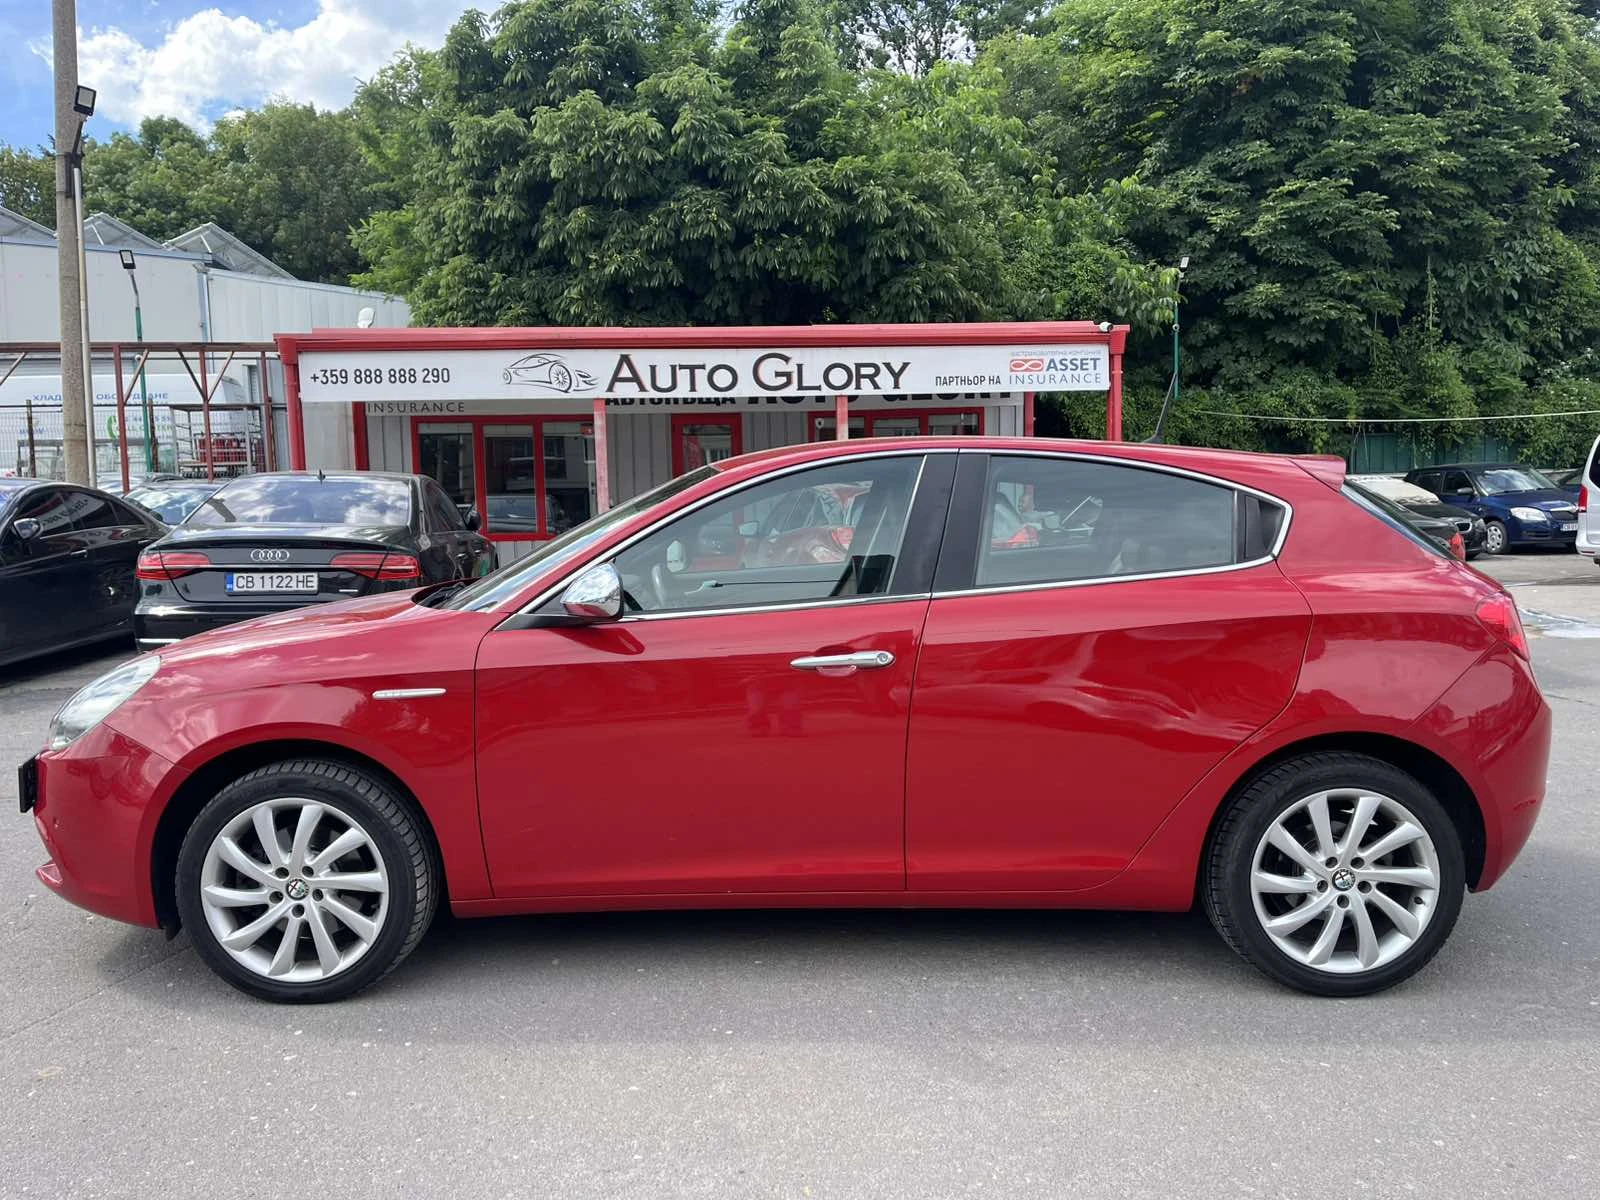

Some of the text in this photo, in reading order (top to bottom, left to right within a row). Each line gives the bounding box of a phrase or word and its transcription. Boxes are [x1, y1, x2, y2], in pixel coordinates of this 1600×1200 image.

[1046, 357, 1101, 372] ASSET
[310, 367, 450, 385] +359 888 888 290
[935, 375, 1002, 386] ПАРТНЬОР НА
[1009, 373, 1102, 385] INSURANCE
[367, 401, 465, 413] INSURANCE
[236, 574, 315, 589] CB 1122 HE
